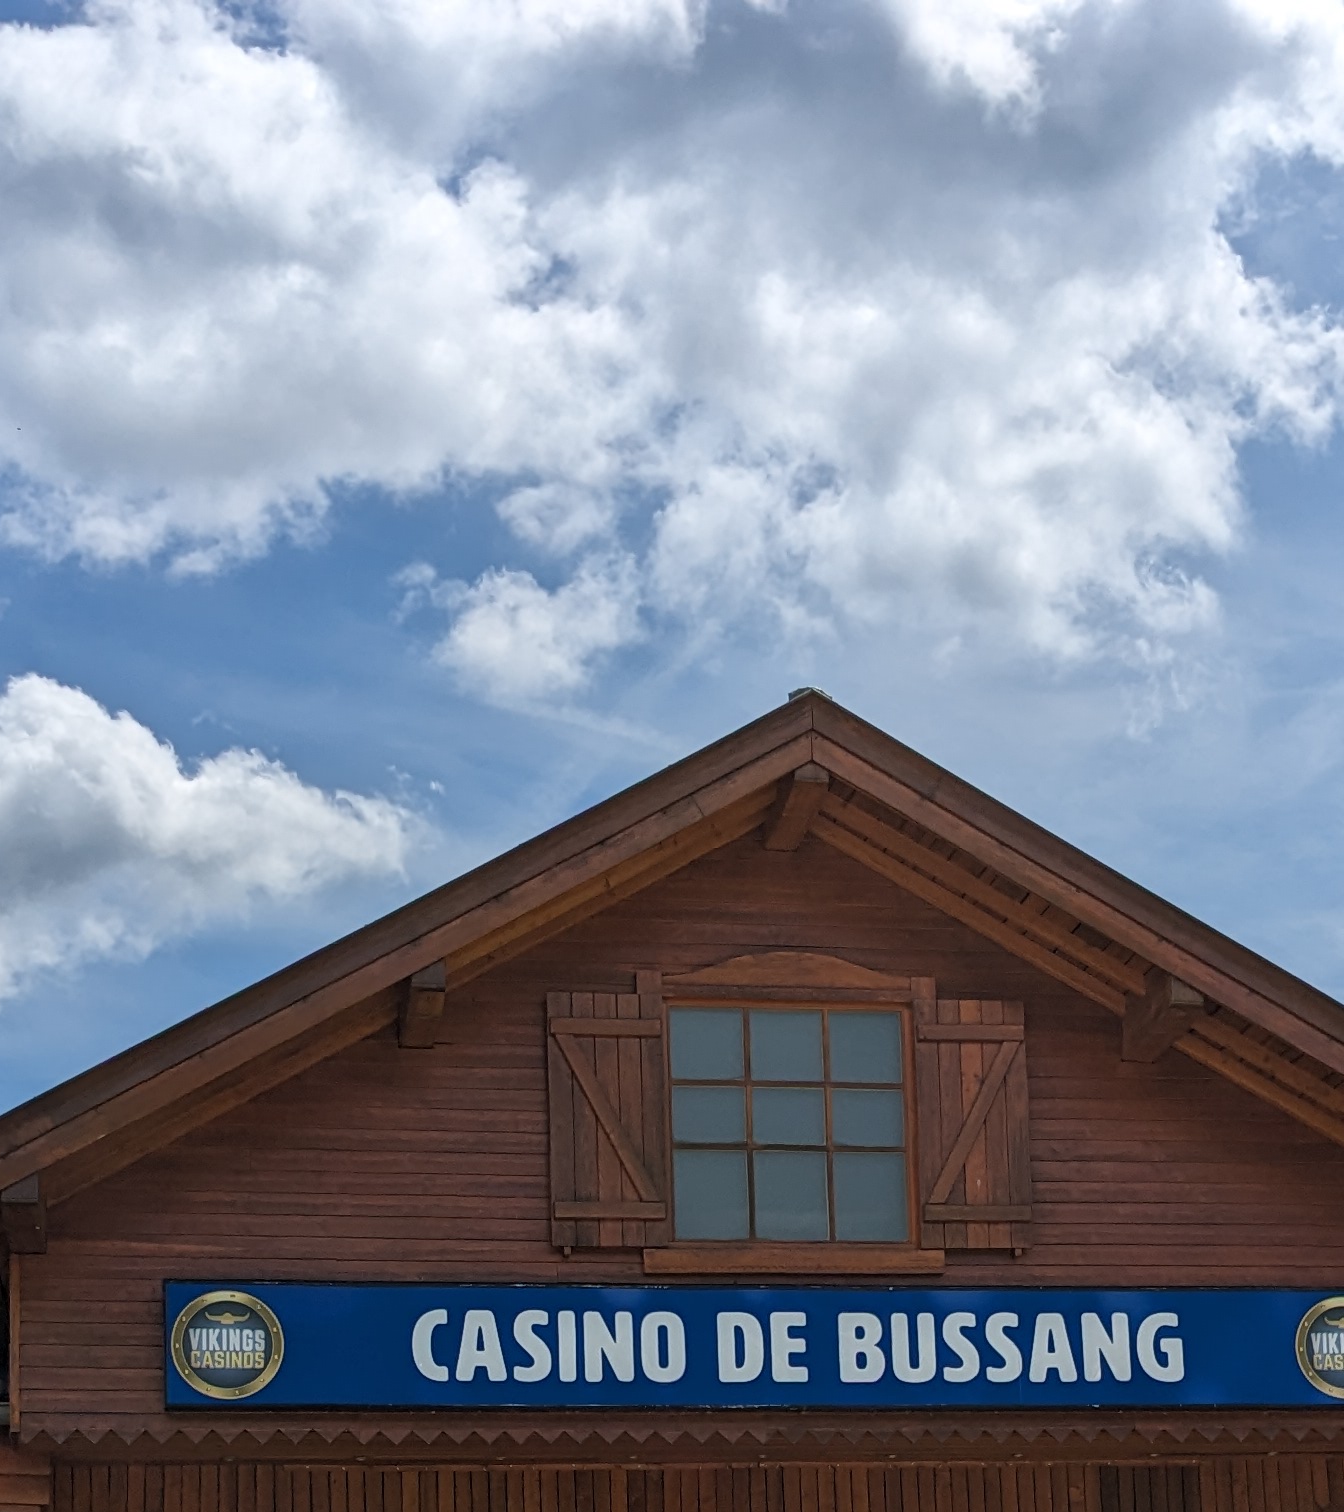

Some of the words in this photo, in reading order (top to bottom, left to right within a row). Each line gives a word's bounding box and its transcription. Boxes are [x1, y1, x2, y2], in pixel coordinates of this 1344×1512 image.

[188, 1328, 266, 1352] VIKINGS
[411, 1308, 687, 1383] CASINO
[716, 1310, 809, 1384] DE
[837, 1311, 1185, 1384] BUSSANG
[190, 1350, 266, 1369] CASINOS
